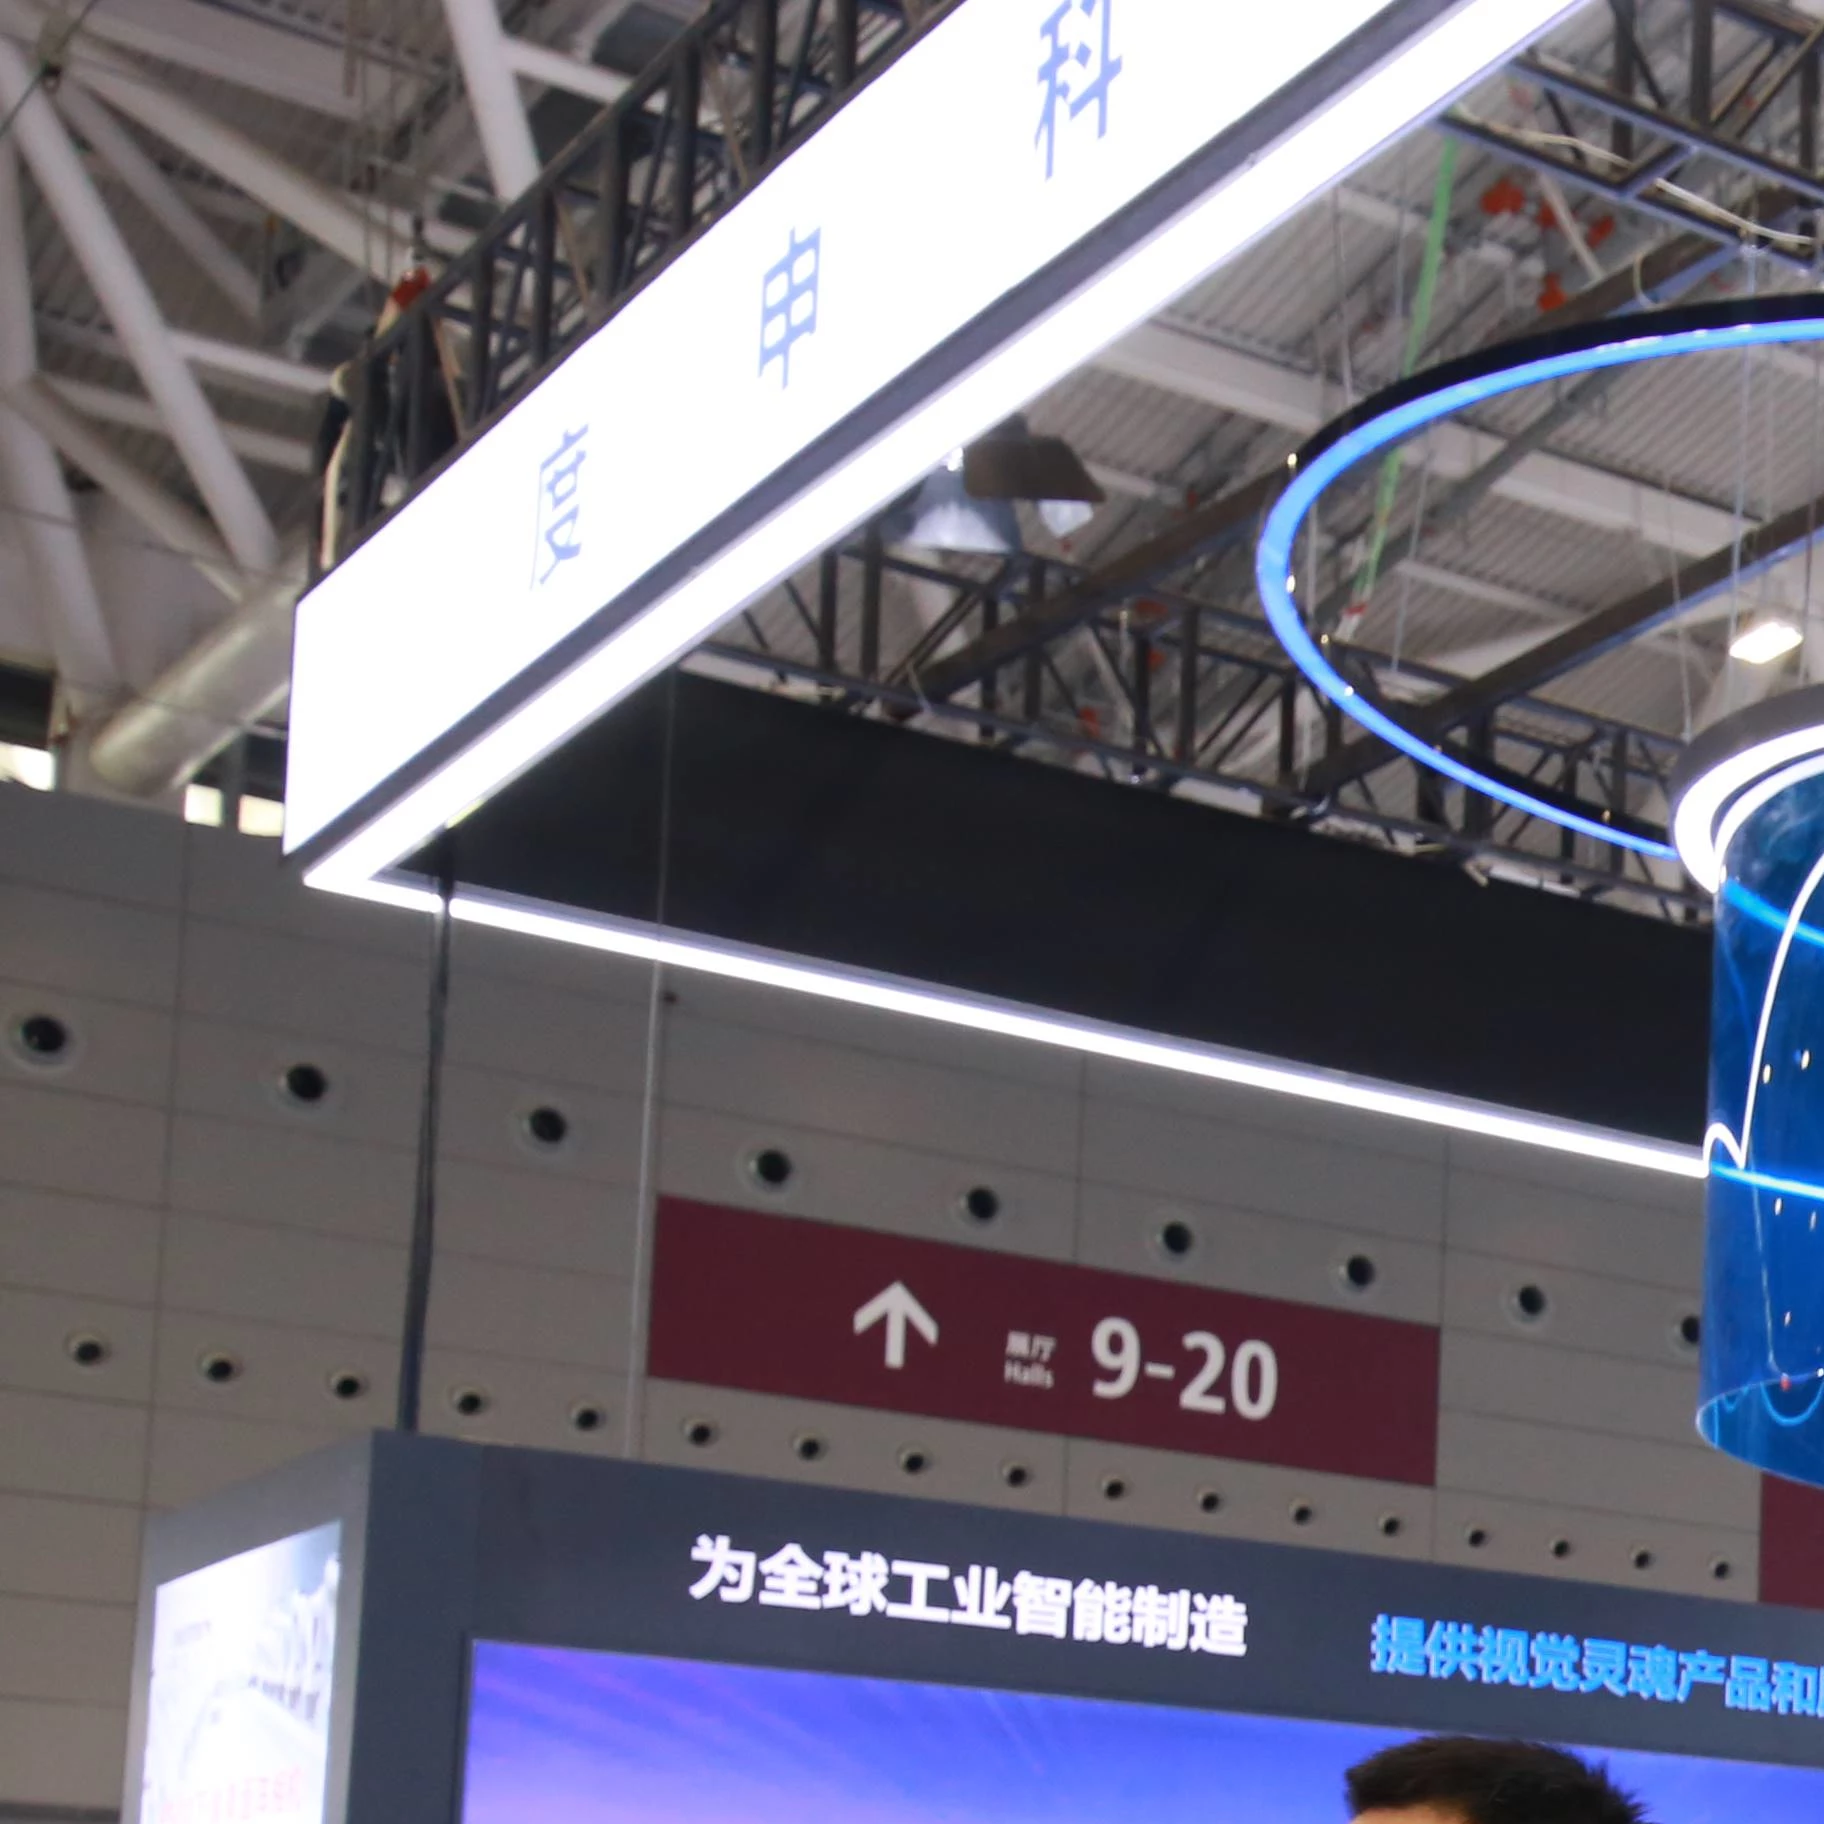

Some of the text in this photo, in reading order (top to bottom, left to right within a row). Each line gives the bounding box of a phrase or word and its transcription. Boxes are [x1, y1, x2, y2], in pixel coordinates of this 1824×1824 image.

[1004, 1359, 1054, 1389] Halls
[1091, 1316, 1278, 1421] 9-20
[690, 1535, 1248, 1657] 为全球工业智能制造
